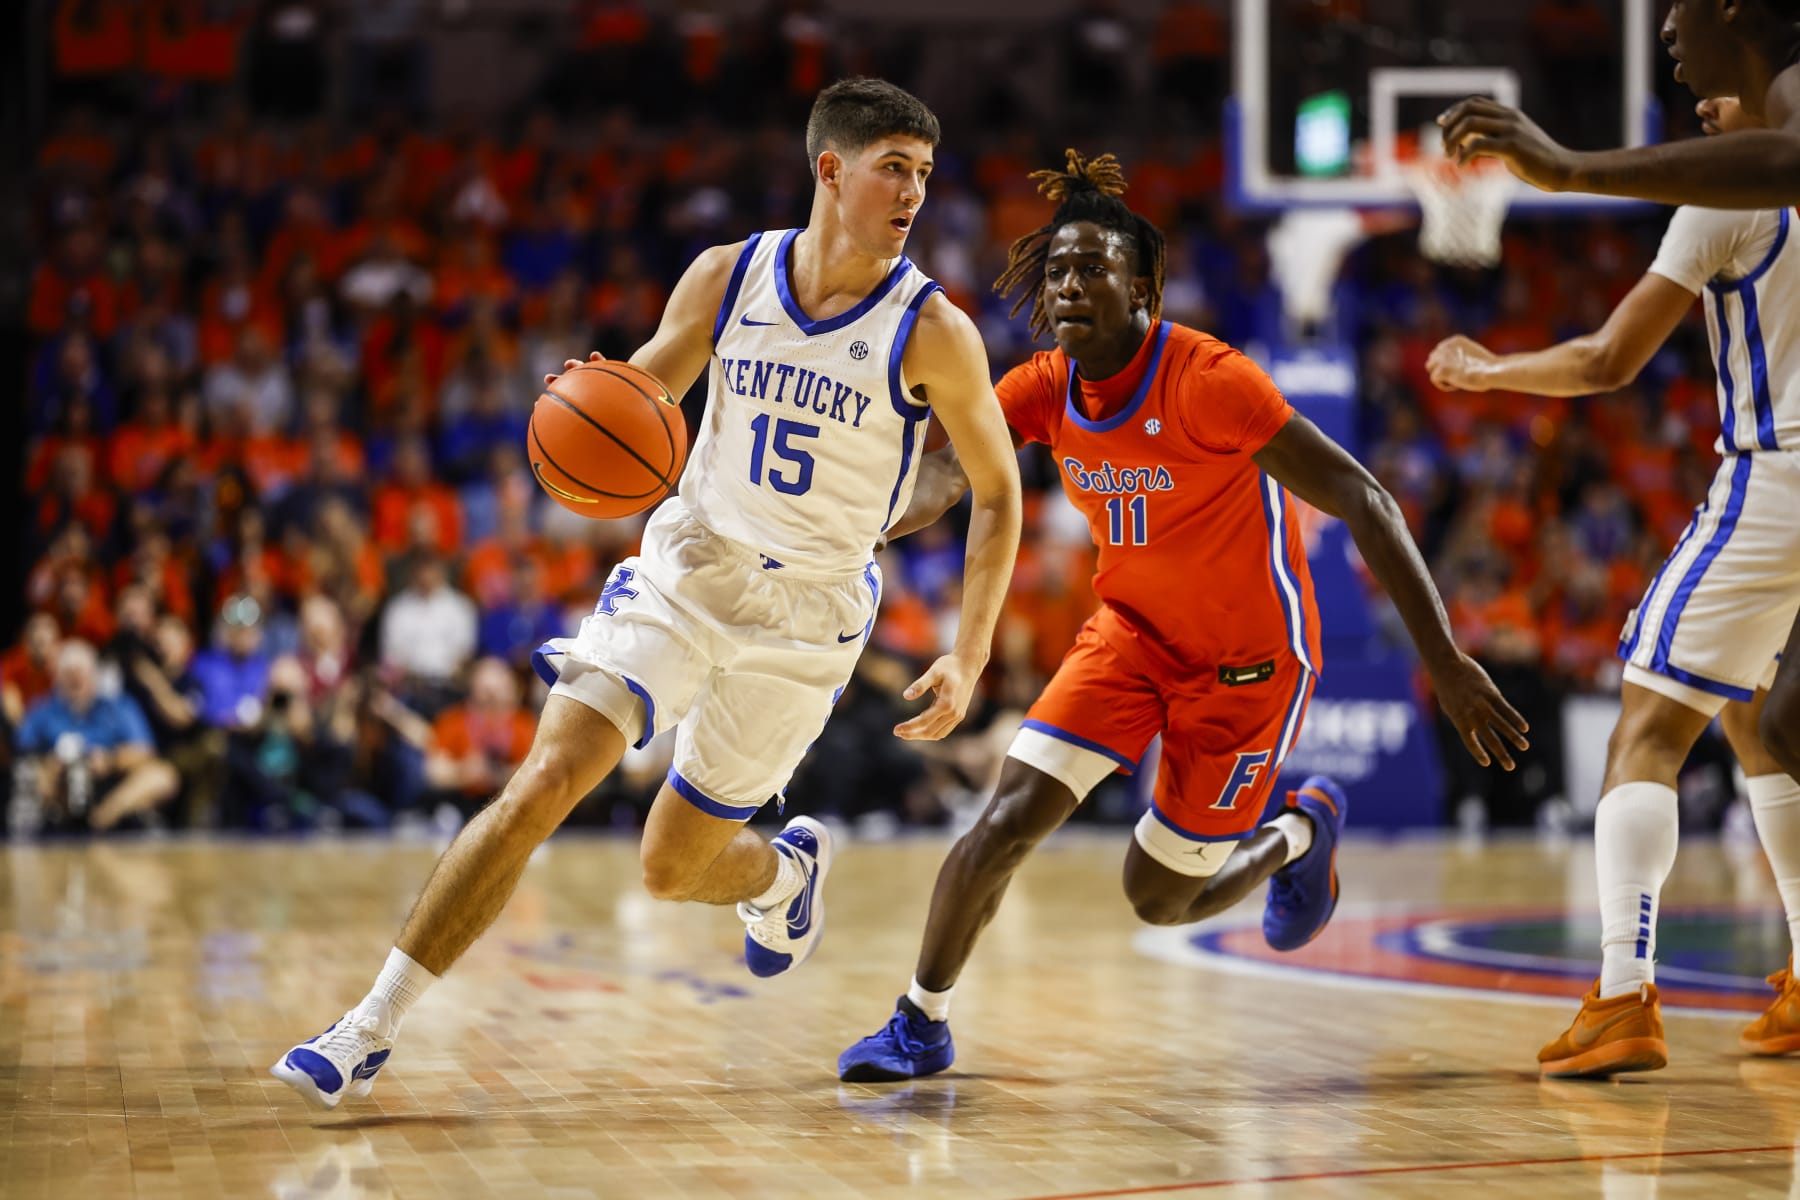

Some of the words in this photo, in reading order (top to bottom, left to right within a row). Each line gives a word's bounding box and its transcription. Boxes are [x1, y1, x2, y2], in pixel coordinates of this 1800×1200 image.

[850, 341, 868, 359] SEC
[722, 358, 872, 428] KENTUCKY
[1145, 418, 1161, 434] SEC
[750, 413, 821, 497] 15
[1063, 457, 1174, 494] Gators
[1106, 495, 1148, 546] 11
[1208, 748, 1272, 810] F
